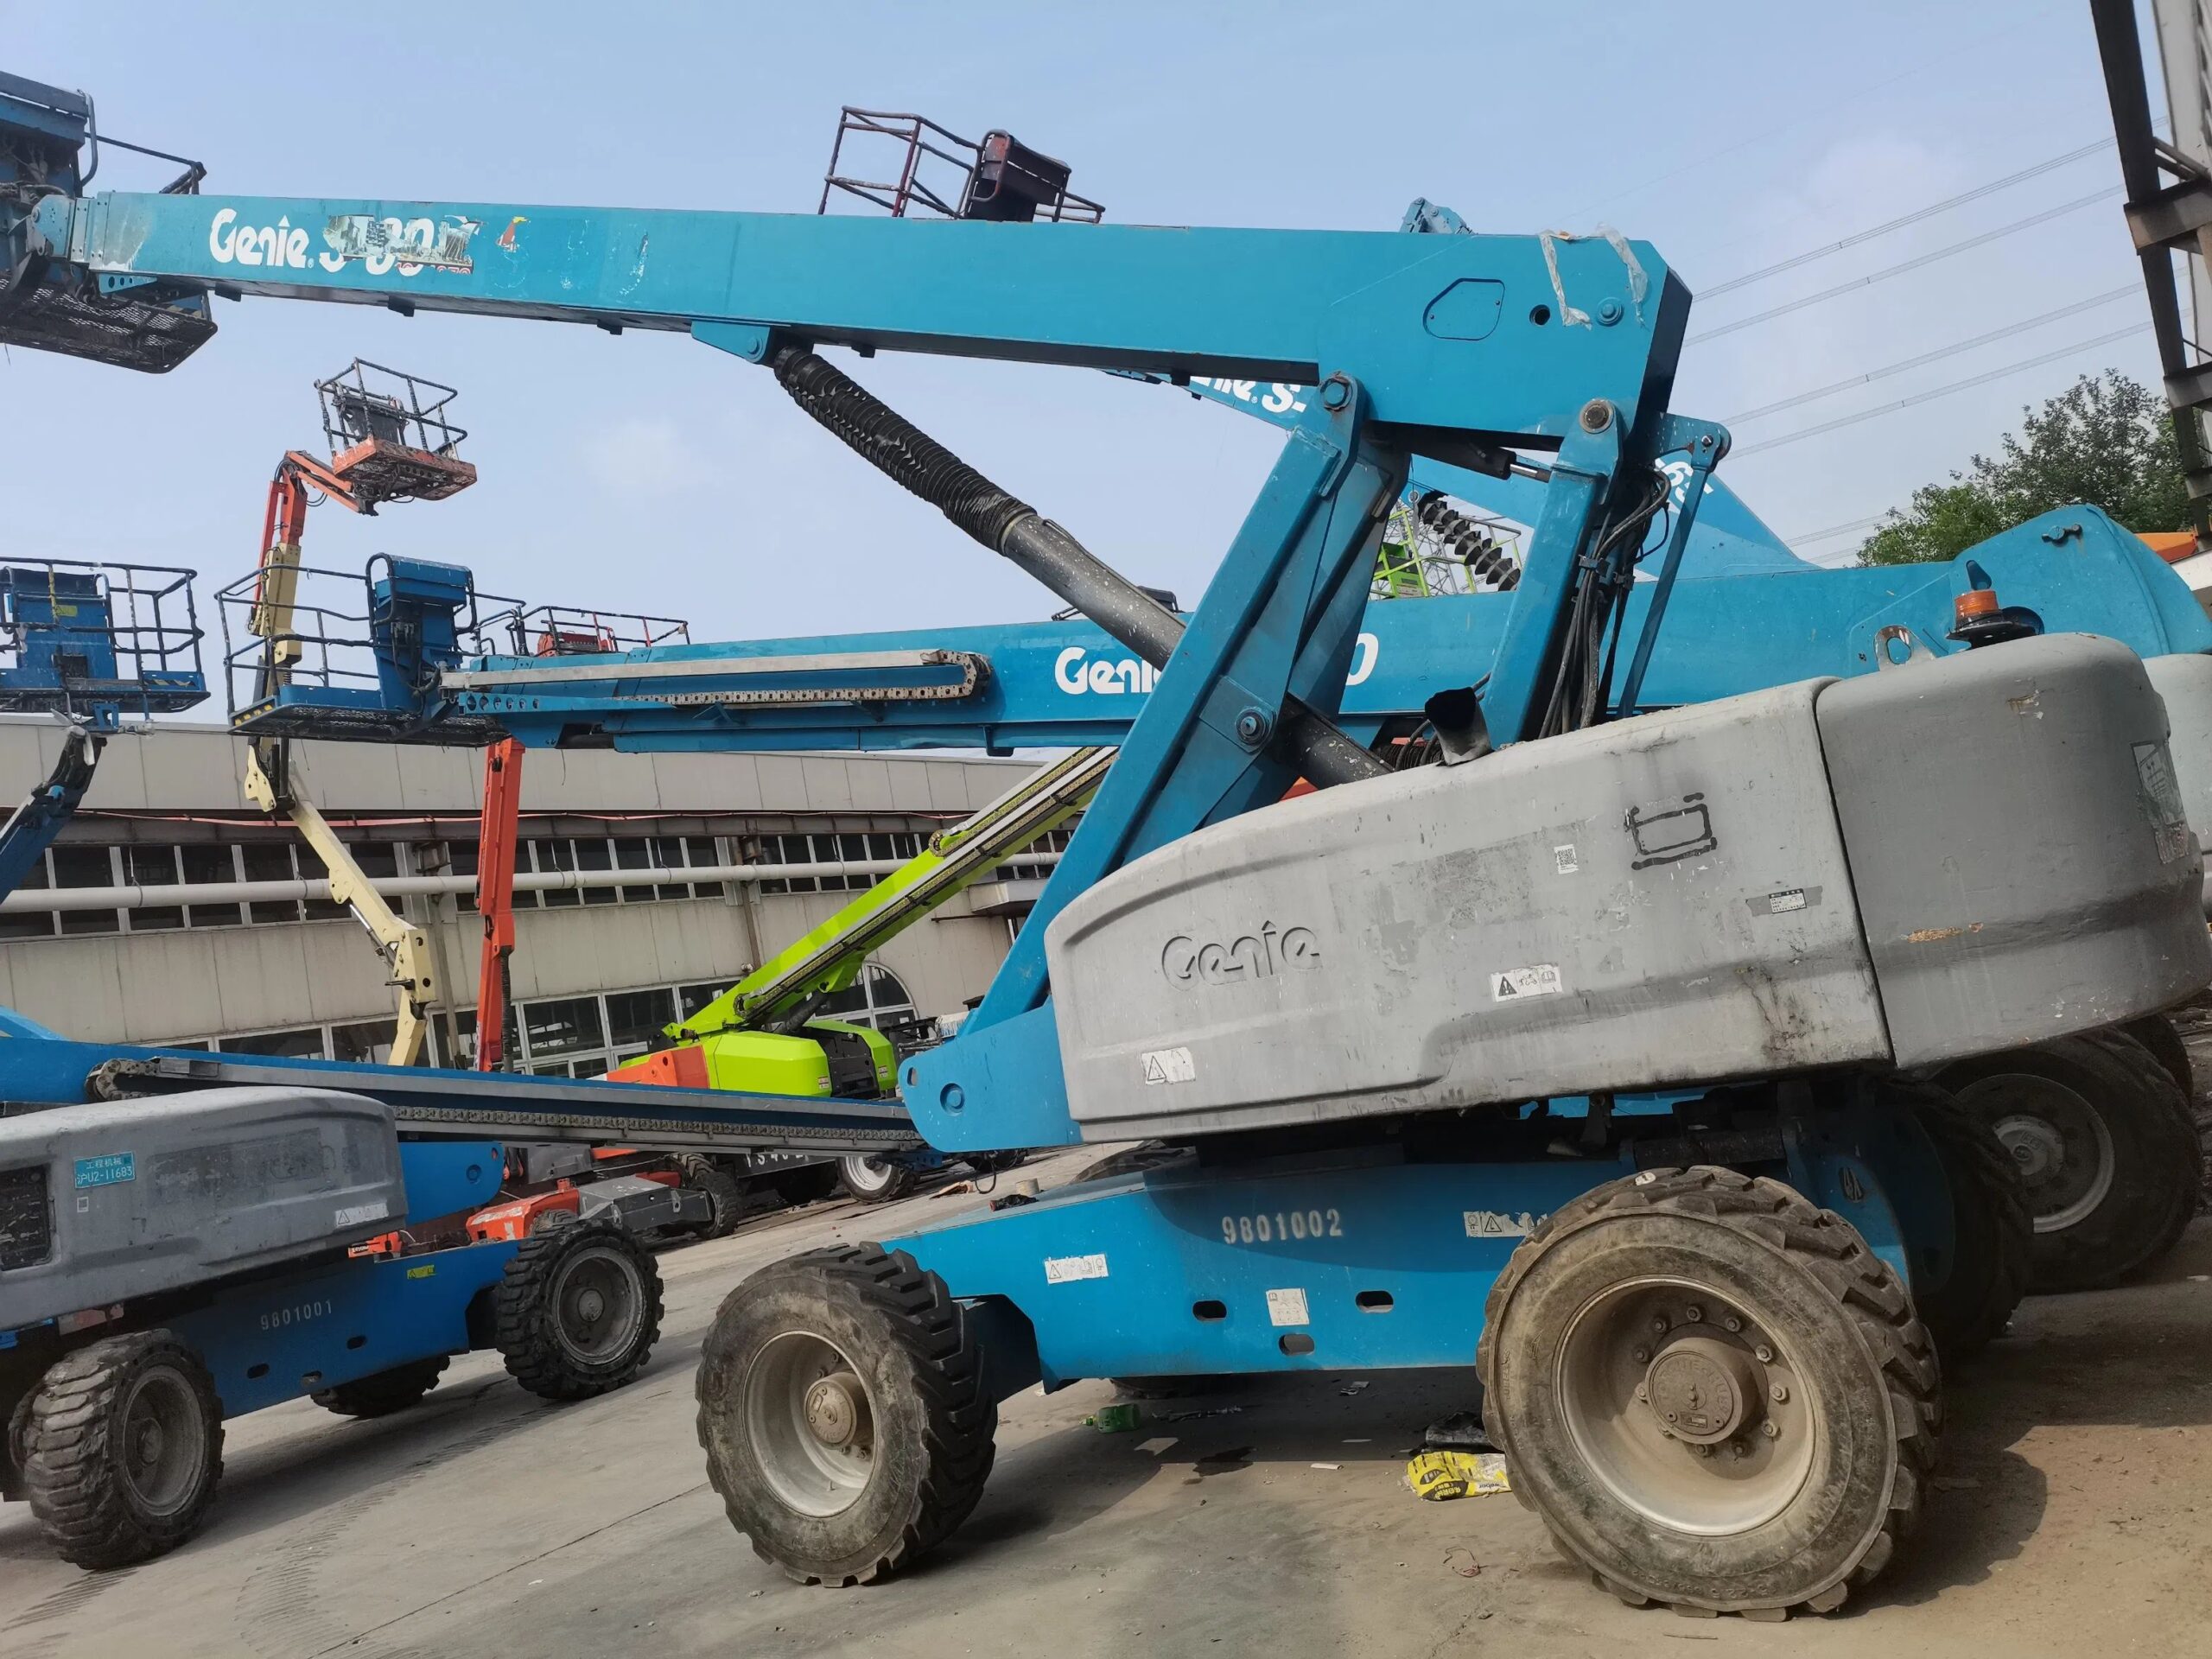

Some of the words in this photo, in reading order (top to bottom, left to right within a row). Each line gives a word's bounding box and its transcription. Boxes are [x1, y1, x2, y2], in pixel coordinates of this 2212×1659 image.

[210, 208, 309, 268] Genie
[1054, 646, 1163, 695] Geni
[1161, 920, 1324, 991] Genie
[1222, 1208, 1344, 1245] 9801002
[260, 1300, 333, 1331] 9801001
